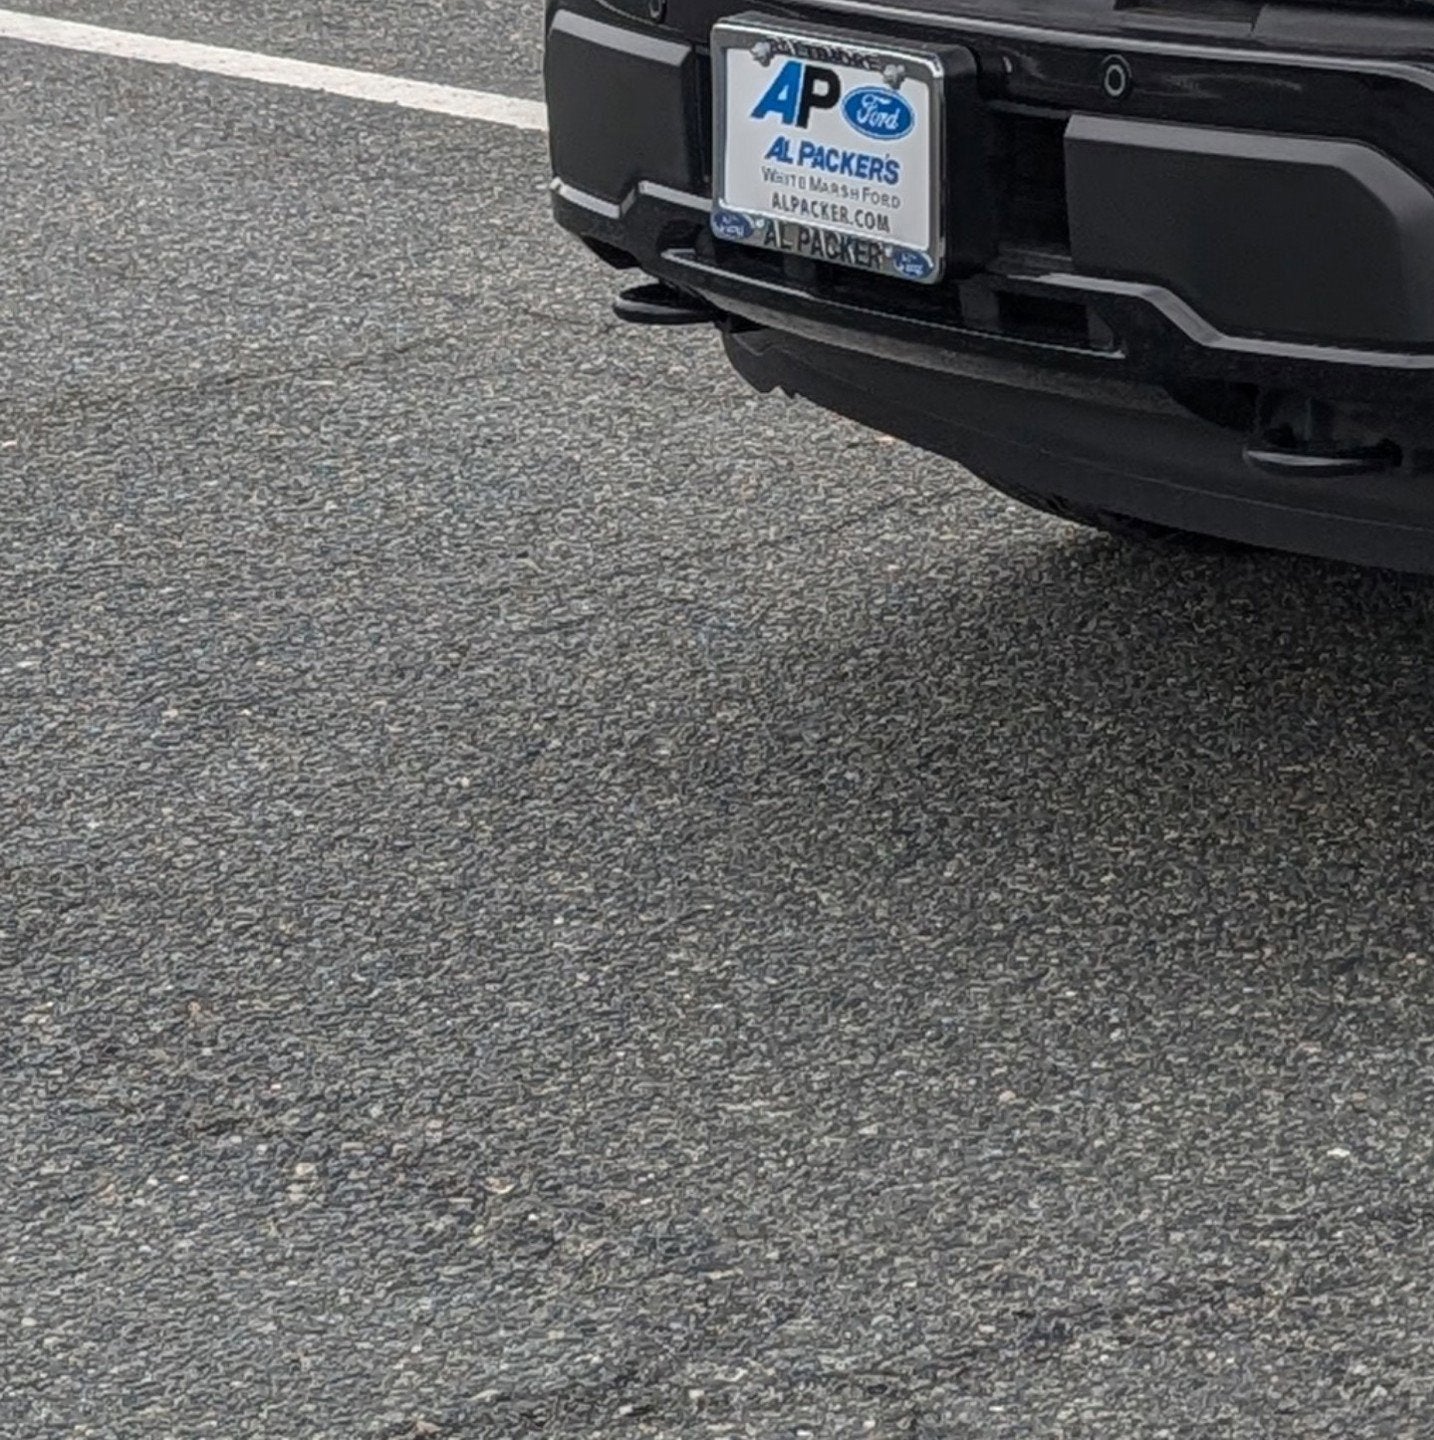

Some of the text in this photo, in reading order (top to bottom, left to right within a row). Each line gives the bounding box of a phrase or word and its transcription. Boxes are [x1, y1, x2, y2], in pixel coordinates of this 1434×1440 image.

[750, 60, 841, 130] AP
[856, 93, 901, 130] Ford
[764, 136, 900, 185] AL PACKER'S
[771, 192, 890, 233] ALPACKER.COM
[862, 186, 901, 209] FORD
[763, 220, 793, 250] AL
[797, 225, 882, 269] PACKER
